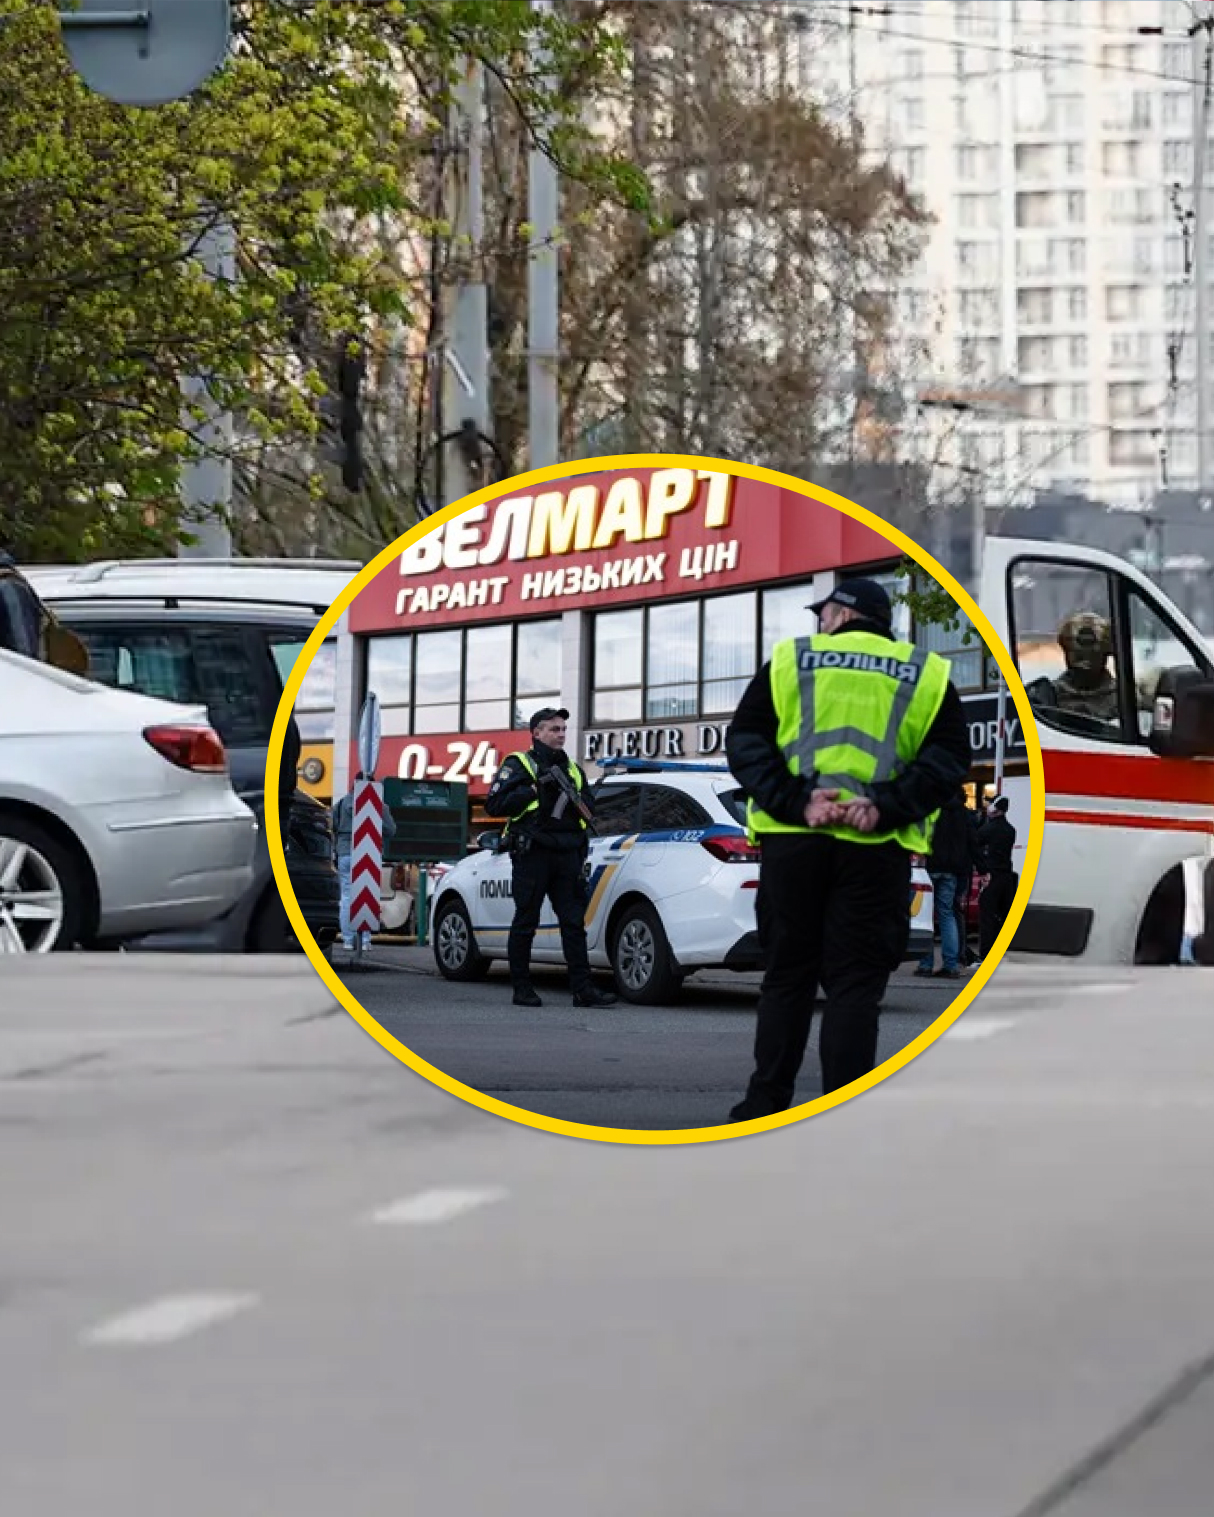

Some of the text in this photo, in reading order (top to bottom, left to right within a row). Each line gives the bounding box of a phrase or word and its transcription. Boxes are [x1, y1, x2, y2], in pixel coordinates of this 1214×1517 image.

[399, 468, 732, 576] ВЕЛМАРТ
[395, 539, 739, 615] ГАРАНТ НИЗЬКИХ ЦІН
[800, 650, 918, 682] ПОЛІЦІЯ
[397, 740, 498, 784] 0-24
[584, 727, 683, 761] FLEUR
